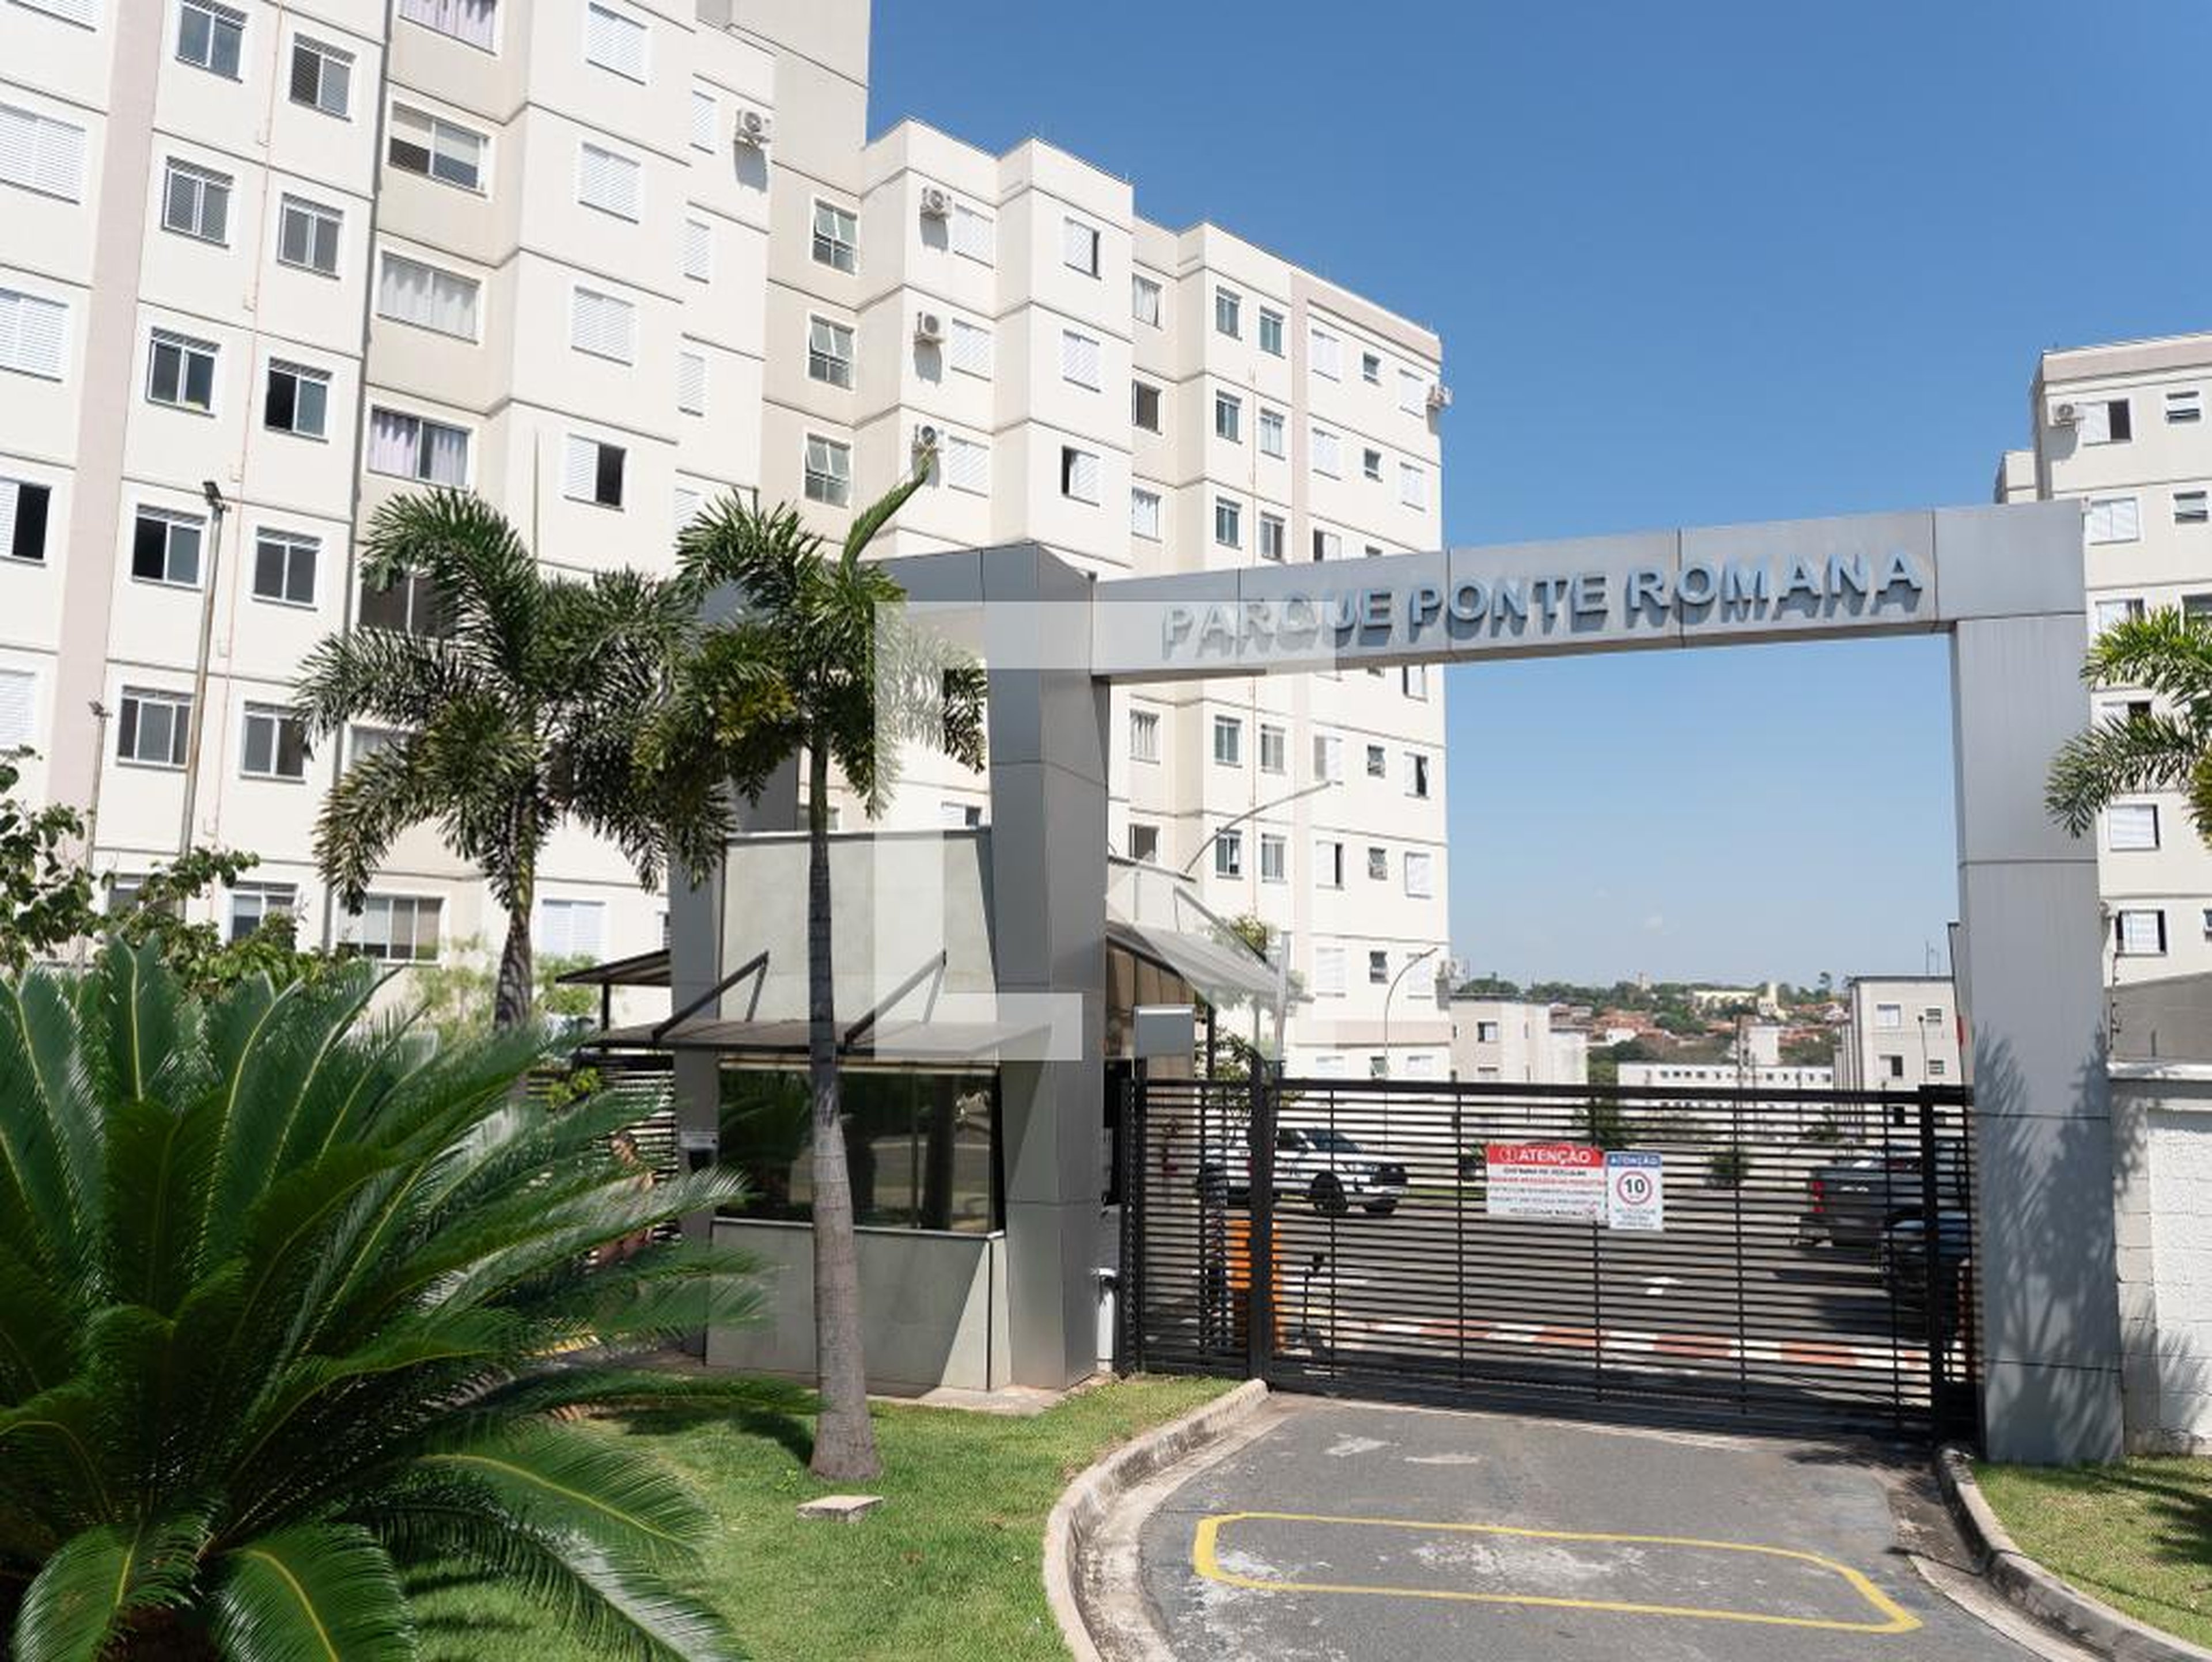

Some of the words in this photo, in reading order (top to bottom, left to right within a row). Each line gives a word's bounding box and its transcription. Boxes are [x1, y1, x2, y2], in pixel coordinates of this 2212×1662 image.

[1164, 589, 1393, 642] PARQUE
[1411, 574, 1608, 625] PONTE
[1626, 551, 1923, 611] ROMANA
[1519, 1148, 1592, 1164] ATENÇÃO
[1624, 1178, 1645, 1194] 10
